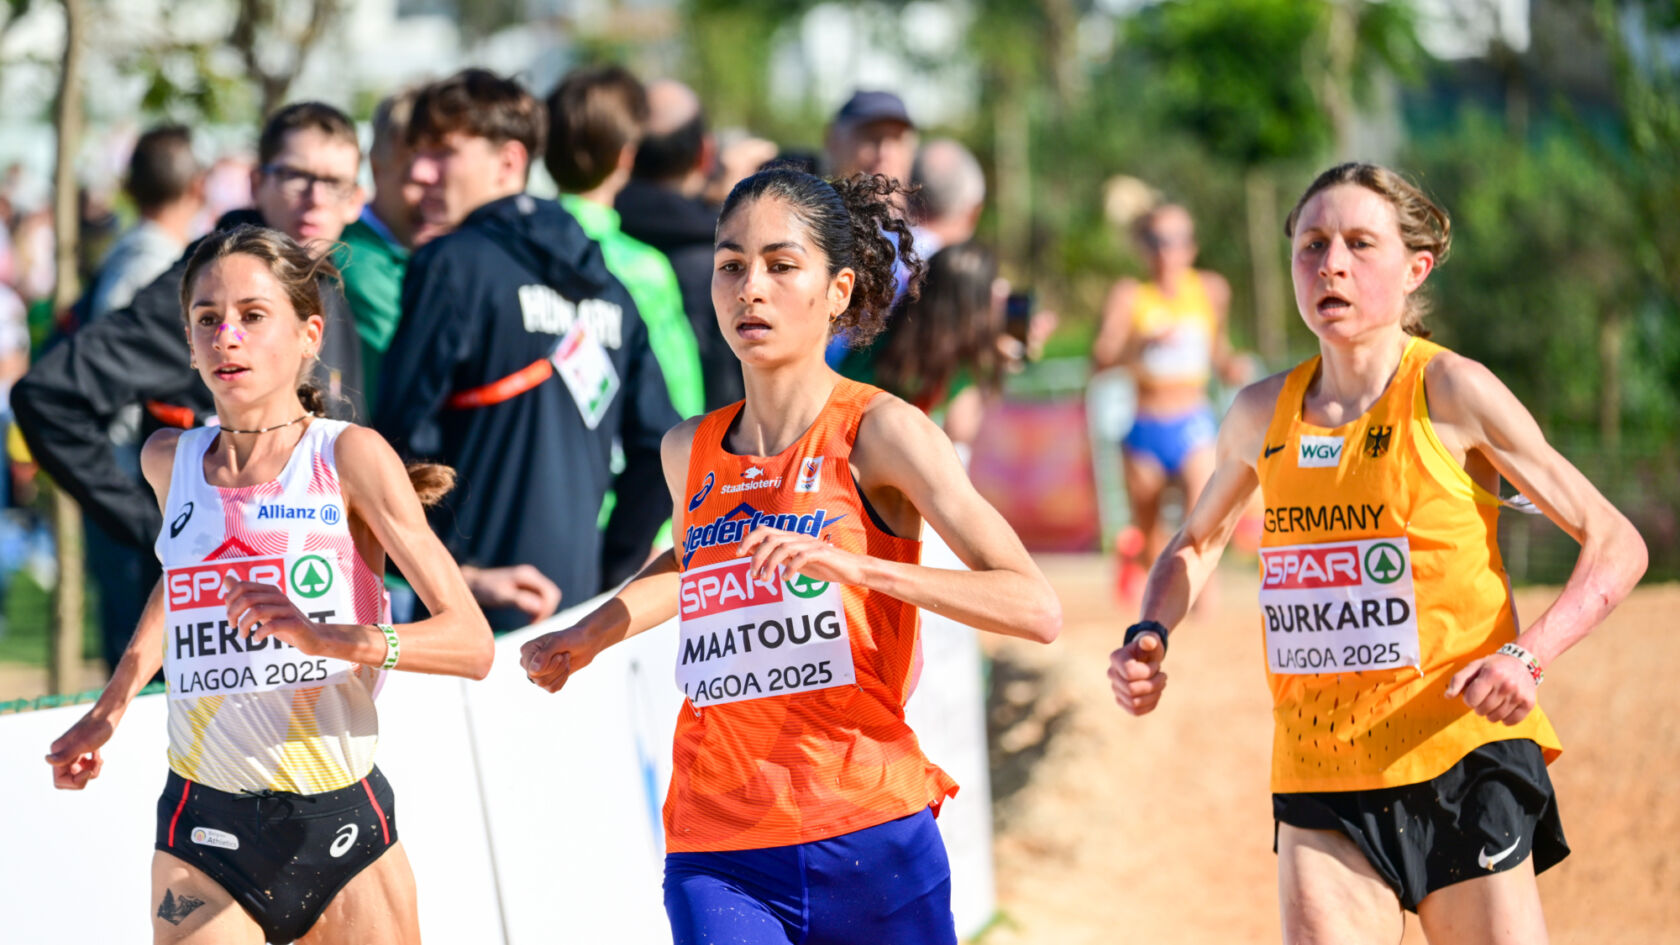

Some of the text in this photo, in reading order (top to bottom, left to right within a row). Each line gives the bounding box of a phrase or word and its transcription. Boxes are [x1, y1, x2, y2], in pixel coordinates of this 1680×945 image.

[1301, 444, 1342, 459] WGV
[721, 476, 783, 494] Staatsloterij
[257, 504, 316, 520] Allianz
[1264, 503, 1384, 533] GERMANY
[1266, 551, 1358, 585] SPAR
[681, 567, 778, 614] SPAR
[1265, 597, 1410, 633] BURKARD
[175, 609, 336, 660] HERBT
[682, 610, 841, 666] MAATOUG
[1277, 643, 1400, 668] LAGOA 2025
[180, 659, 328, 693] LAGOA 2025
[685, 660, 833, 703] LAGOA 2025
